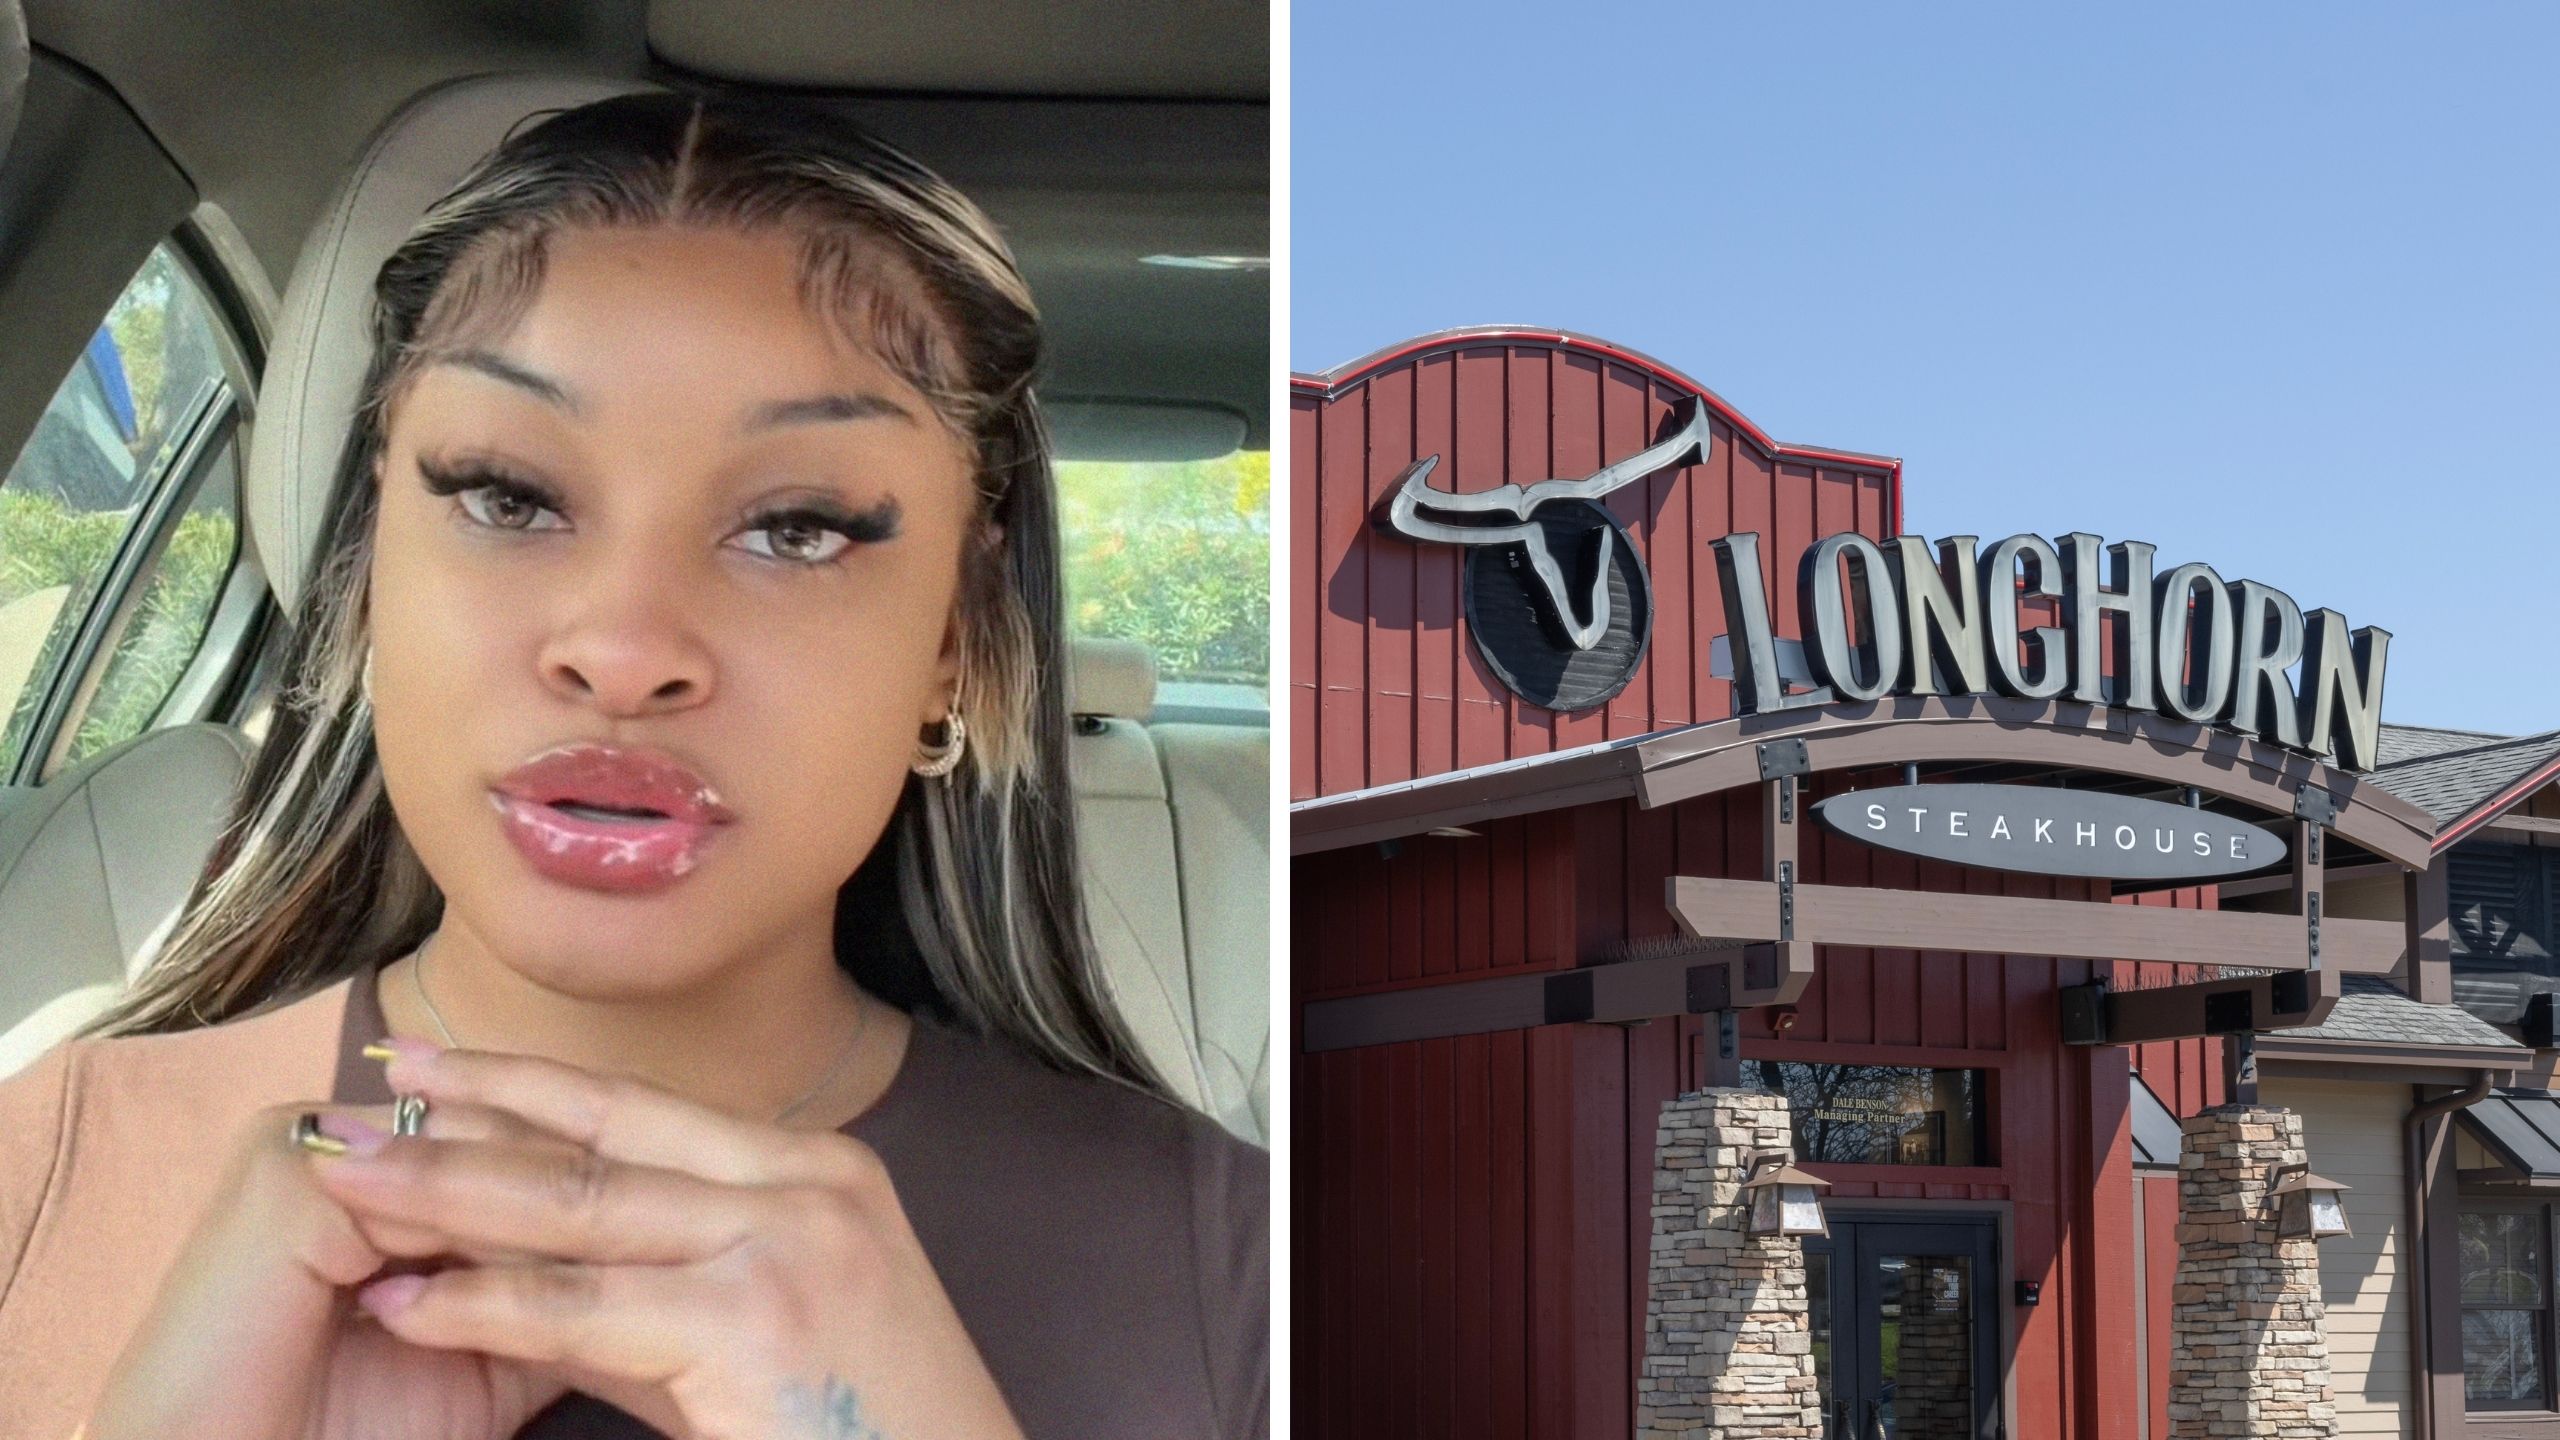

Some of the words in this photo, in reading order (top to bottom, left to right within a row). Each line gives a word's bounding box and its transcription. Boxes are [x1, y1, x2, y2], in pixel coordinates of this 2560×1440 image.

[1708, 531, 2393, 773] LONGHORN
[1866, 803, 2249, 860] STEAKHOUSE
[1814, 1108, 1864, 1123] Managing
[1867, 1111, 1905, 1123] Partner
[1832, 1097, 1854, 1108] DALE
[1855, 1099, 1889, 1110] BENSON
